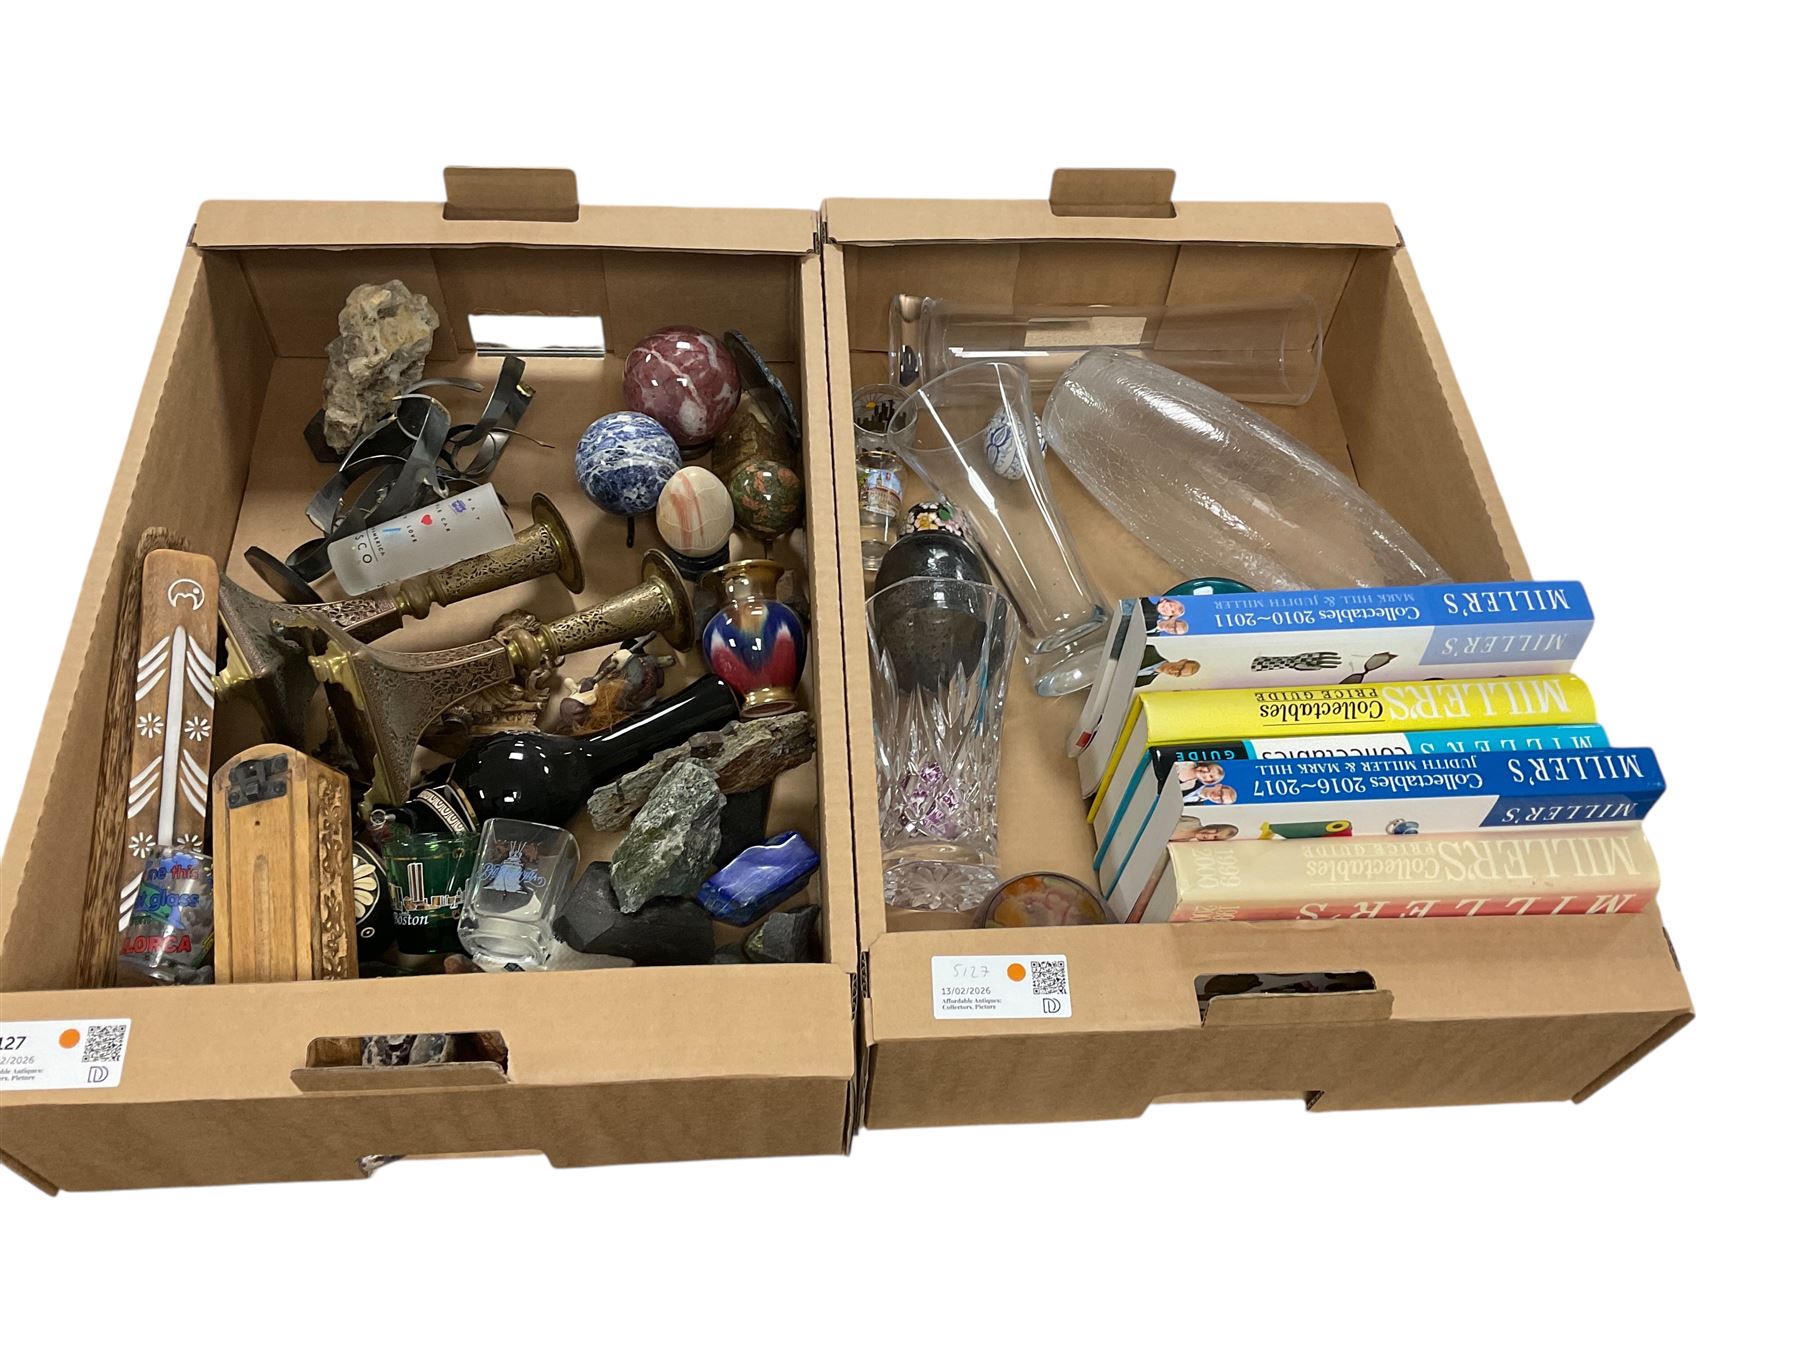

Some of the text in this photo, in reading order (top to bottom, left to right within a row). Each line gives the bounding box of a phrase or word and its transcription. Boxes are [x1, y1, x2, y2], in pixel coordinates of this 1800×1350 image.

[1214, 593, 1416, 610] MARK HILL & JUDITH MILLER
[1214, 588, 1572, 628] MILLER'S Collectables 2010~2011
[1441, 633, 1568, 657] MILLER'S
[1254, 687, 1378, 702] PRICE GUIDE
[1260, 678, 1571, 722] MILLER'S Collectables
[1175, 750, 1236, 762] GUIDE
[1255, 754, 1478, 776] JUDITH MILLER & MARK HILL
[1253, 754, 1645, 797] MILLER'S Collectables 2016~2017
[1501, 802, 1639, 828] MILLER'S
[1302, 840, 1436, 858] PRICE GUIDE
[1306, 836, 1642, 881] MILLER'S Collectables
[1191, 847, 1219, 889] 2000
[1216, 849, 1242, 888] 1999
[392, 911, 430, 926] Boston
[952, 963, 990, 979] 5127
[942, 986, 992, 995] 13/02/2026
